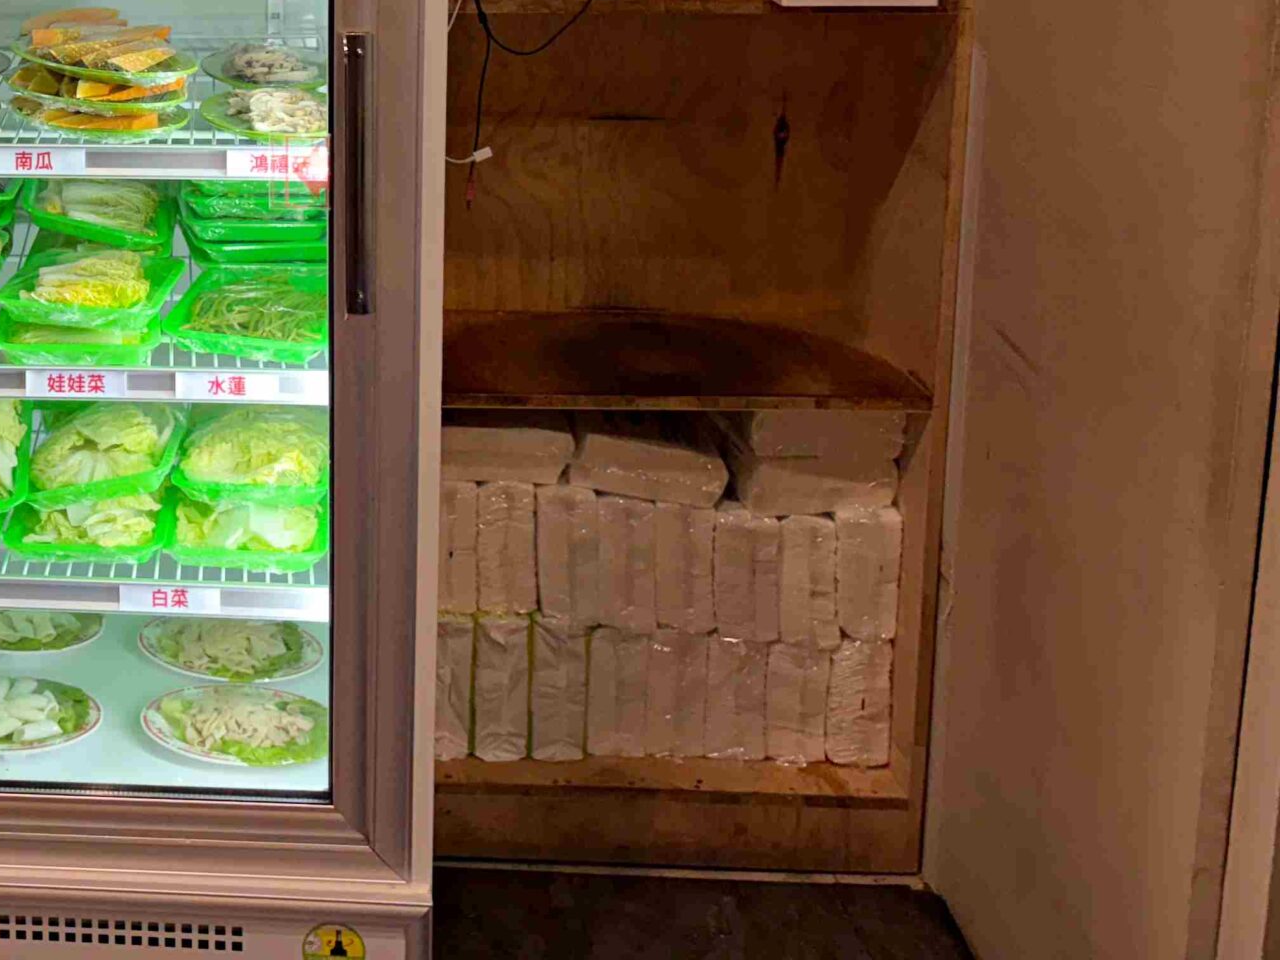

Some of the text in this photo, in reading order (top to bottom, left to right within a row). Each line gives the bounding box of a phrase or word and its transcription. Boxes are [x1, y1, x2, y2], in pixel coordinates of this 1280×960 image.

[14, 151, 53, 172] 南瓜
[47, 373, 106, 394] 娃娃菜
[207, 375, 247, 397] 水蓮
[151, 588, 189, 609] 白菜
